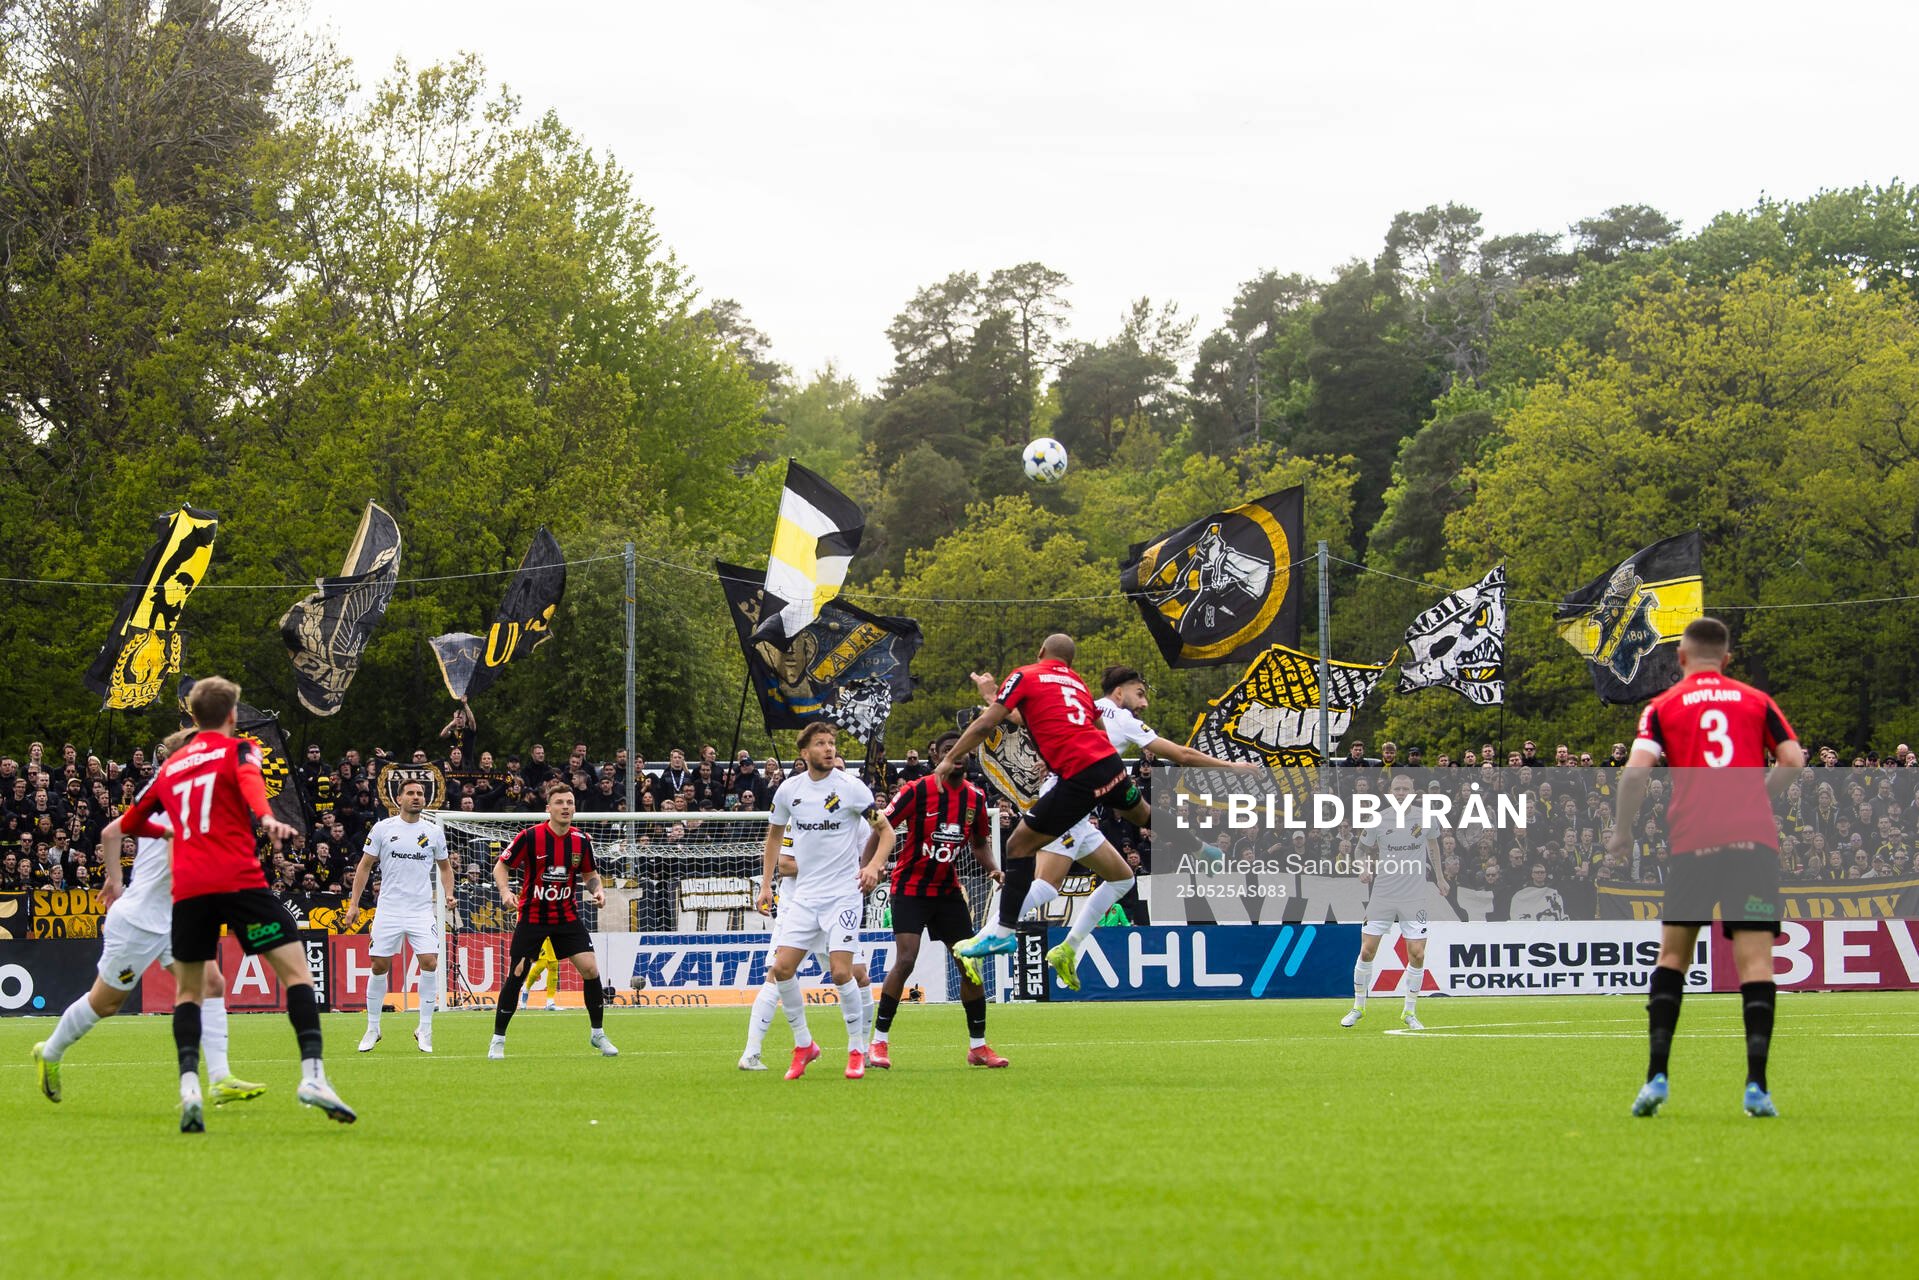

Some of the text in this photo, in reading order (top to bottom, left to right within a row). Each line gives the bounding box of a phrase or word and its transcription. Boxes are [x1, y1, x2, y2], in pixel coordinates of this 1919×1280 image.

[1061, 686, 1086, 726] 5
[1682, 689, 1742, 706] HOVLAND
[1700, 709, 1734, 768] 3
[391, 770, 430, 780] AIK
[172, 771, 217, 841] 77
[391, 850, 428, 861] truecaller
[533, 884, 572, 901] NÖJD
[284, 899, 304, 920] AIK
[1449, 941, 1707, 968] MITSUBISI
[1025, 935, 1044, 996] SELECT
[1450, 972, 1584, 989] FORKLIFT
